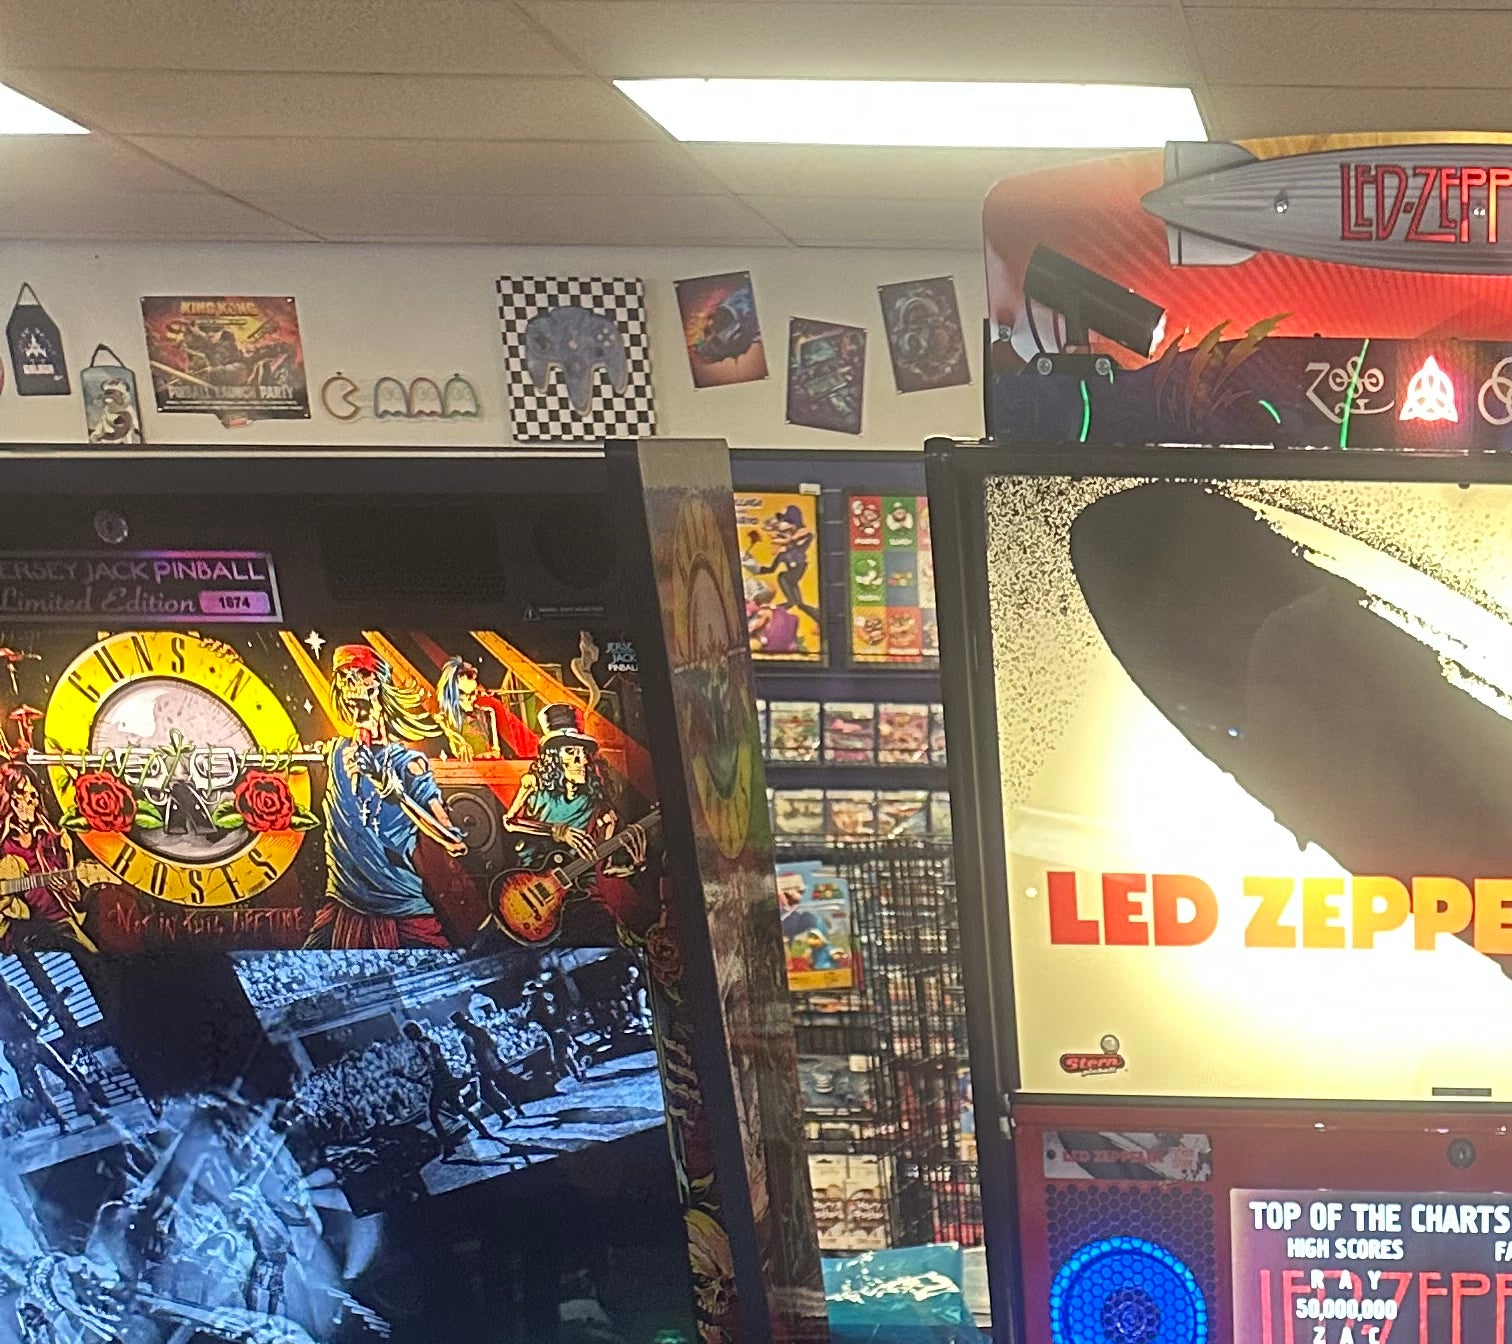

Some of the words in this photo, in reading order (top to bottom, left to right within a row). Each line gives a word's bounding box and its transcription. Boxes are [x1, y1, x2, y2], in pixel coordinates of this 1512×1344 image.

[180, 300, 216, 315] KING
[218, 300, 259, 316] KONG
[259, 385, 294, 399] PARTY
[86, 560, 149, 583] JACK
[153, 557, 265, 584] PINBALL
[101, 585, 196, 613] Edition
[67, 634, 187, 703] GUNS
[111, 845, 279, 905] ROSES
[1046, 871, 1219, 947] LED
[1064, 1055, 1124, 1070] Stern
[1249, 1201, 1301, 1230] TOP
[1309, 1202, 1342, 1232] OF
[1350, 1202, 1401, 1232] THE
[1410, 1203, 1510, 1234] CHARTS
[1286, 1238, 1330, 1259] HIGH
[1334, 1239, 1404, 1260] SCORES
[1295, 1299, 1398, 1321] 50,000,000
